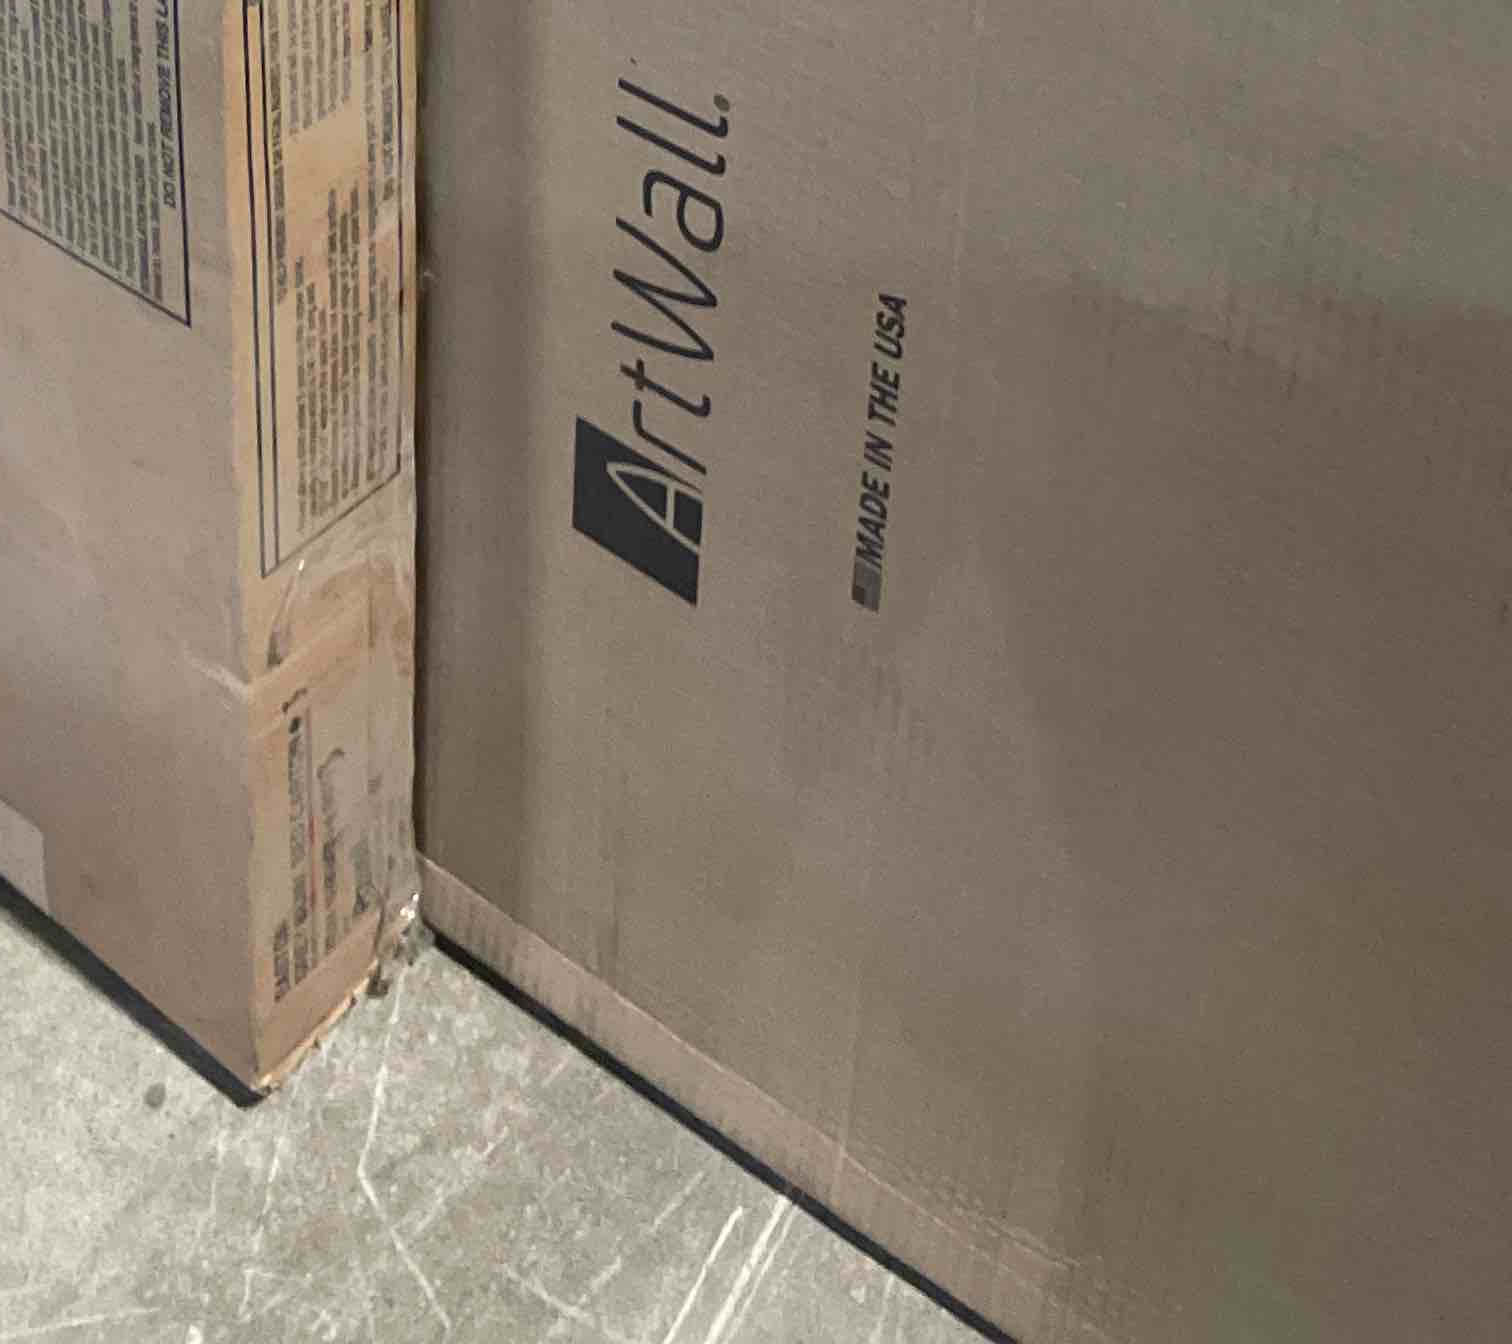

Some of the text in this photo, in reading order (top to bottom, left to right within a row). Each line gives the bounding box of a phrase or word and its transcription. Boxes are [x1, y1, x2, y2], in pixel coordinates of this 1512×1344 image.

[854, 292, 908, 571] MADE IN THE USA
